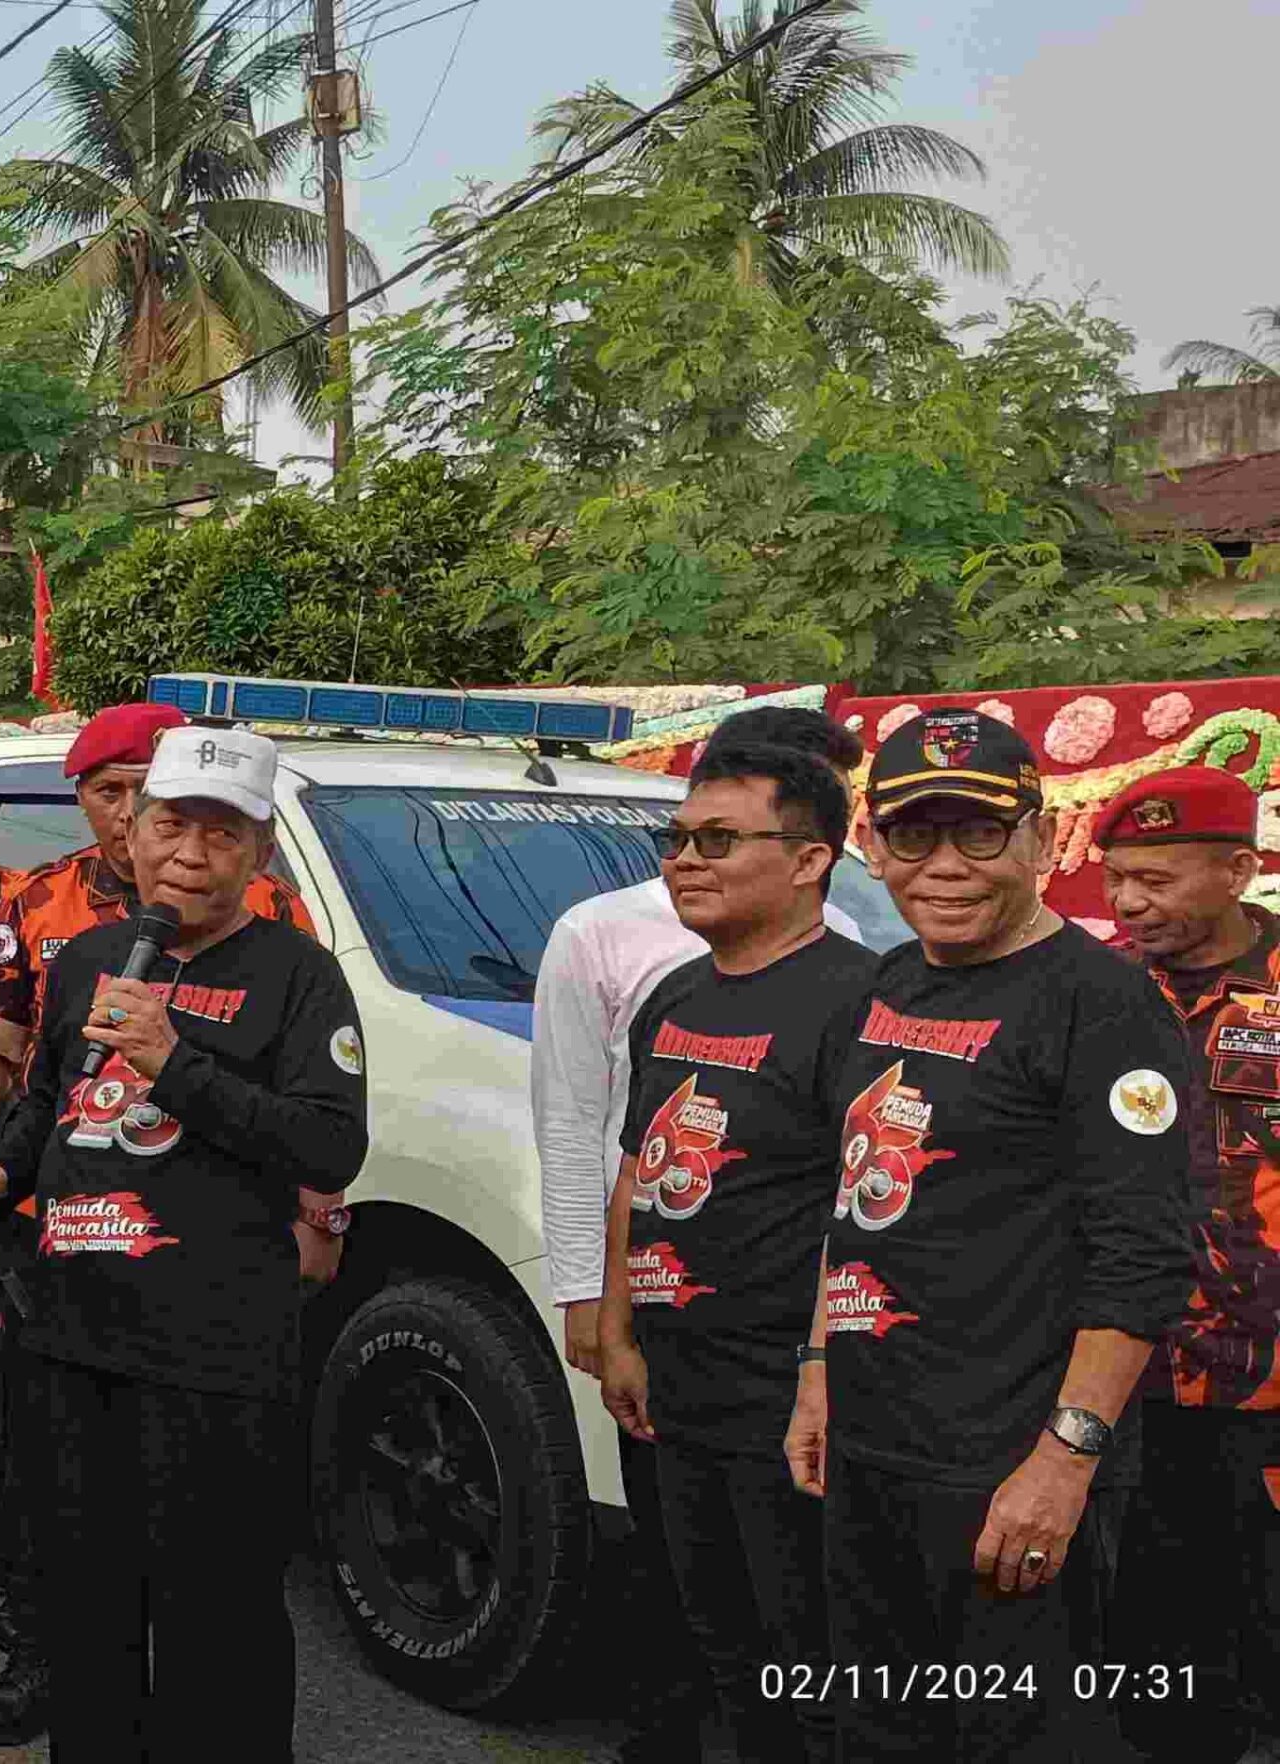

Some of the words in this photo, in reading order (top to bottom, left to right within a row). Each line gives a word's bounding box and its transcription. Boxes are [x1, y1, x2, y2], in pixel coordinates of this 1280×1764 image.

[430, 799, 579, 824] DITLANTAS
[570, 804, 658, 829] POLDA
[682, 1104, 728, 1124] PEMUDA
[886, 1095, 932, 1118] PEMUDA
[47, 1198, 122, 1220] Pemuda
[47, 1216, 149, 1237] Pancasila
[359, 1330, 464, 1373] DUNLOP
